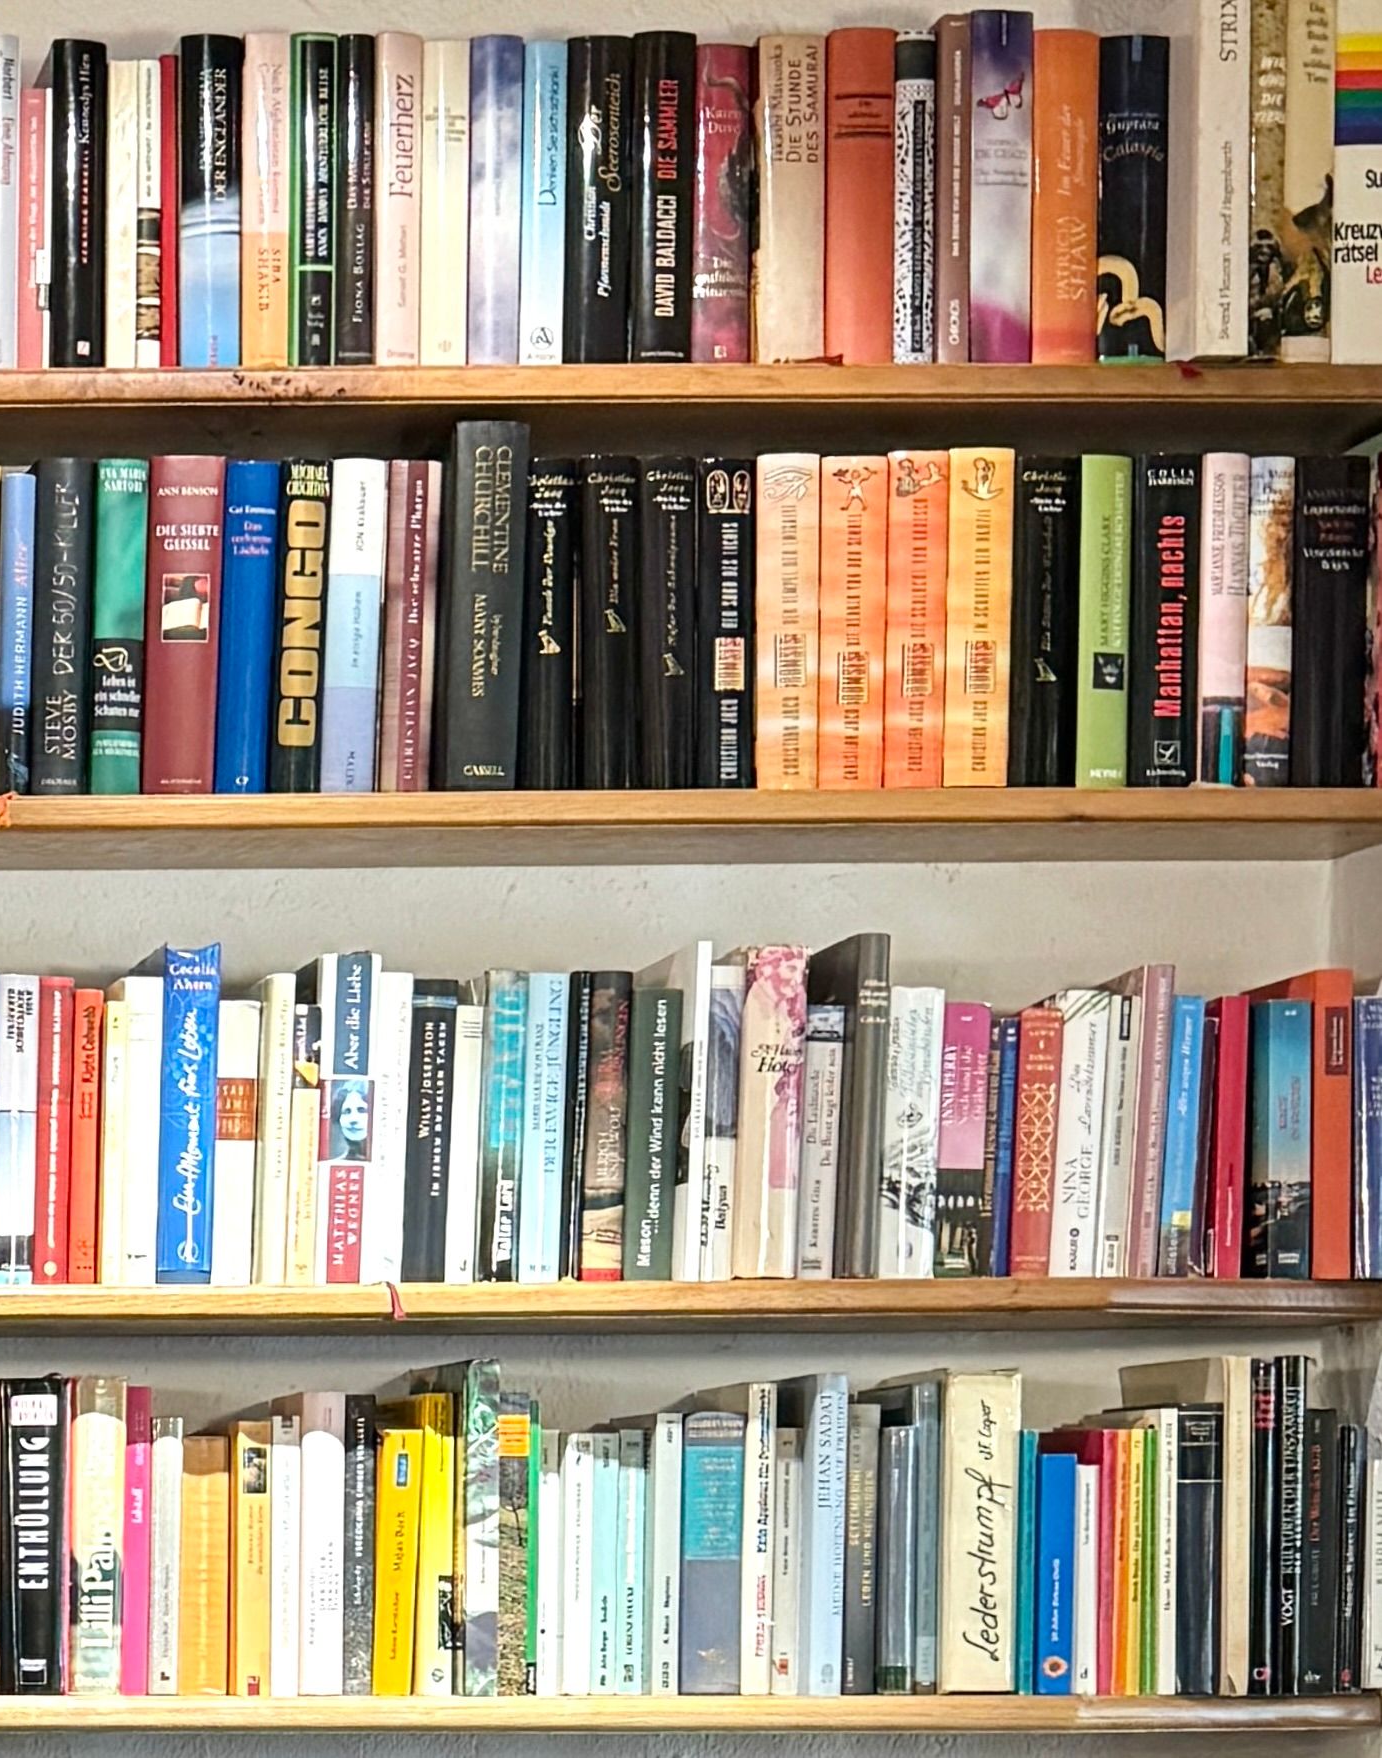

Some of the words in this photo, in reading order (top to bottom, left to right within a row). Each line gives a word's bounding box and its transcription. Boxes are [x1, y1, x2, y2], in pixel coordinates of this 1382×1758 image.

[786, 59, 802, 127] STUNDE
[804, 45, 819, 121] SAMURAI
[390, 74, 414, 198] Feuerherz
[598, 73, 623, 192] Seerosenteich
[658, 80, 679, 150] SAMMLER
[659, 155, 678, 179] DIE
[787, 136, 802, 163] DIE
[805, 132, 818, 163] DES
[655, 195, 677, 267] BALDACCI
[1335, 241, 1379, 264] rätsel
[655, 273, 675, 317] DAVID
[471, 445, 492, 572] CHURCHILL
[495, 445, 512, 573] CLEMENTINE
[1156, 515, 1186, 587] nachts
[14, 596, 28, 675] HERMANN
[277, 499, 327, 748] CONGO
[1153, 593, 1188, 717] Manhattan,
[12, 680, 26, 735] JUDITH
[45, 695, 62, 754] STEVE
[61, 689, 78, 760] MOSBY
[346, 964, 362, 1003] Liebe
[344, 1007, 360, 1030] die
[653, 1000, 668, 1037] lesen
[344, 1034, 359, 1069] Aber
[651, 1041, 666, 1074] nicht
[649, 1078, 664, 1113] kann
[649, 1117, 663, 1153] Wind
[649, 1156, 661, 1179] der
[1061, 1158, 1078, 1203] NINA
[1076, 1144, 1094, 1218] GEORGE
[332, 1169, 347, 1265] MATTHIAS
[636, 1219, 651, 1266] Mason
[818, 1390, 833, 1447] SADAT
[817, 1455, 832, 1508] JEHAN
[14, 1437, 50, 1589] ENTHÜLLUNG
[962, 1467, 1013, 1662] Lederstrumpf
[80, 1595, 114, 1648] Lilli
[1279, 1587, 1294, 1627] VOGT
